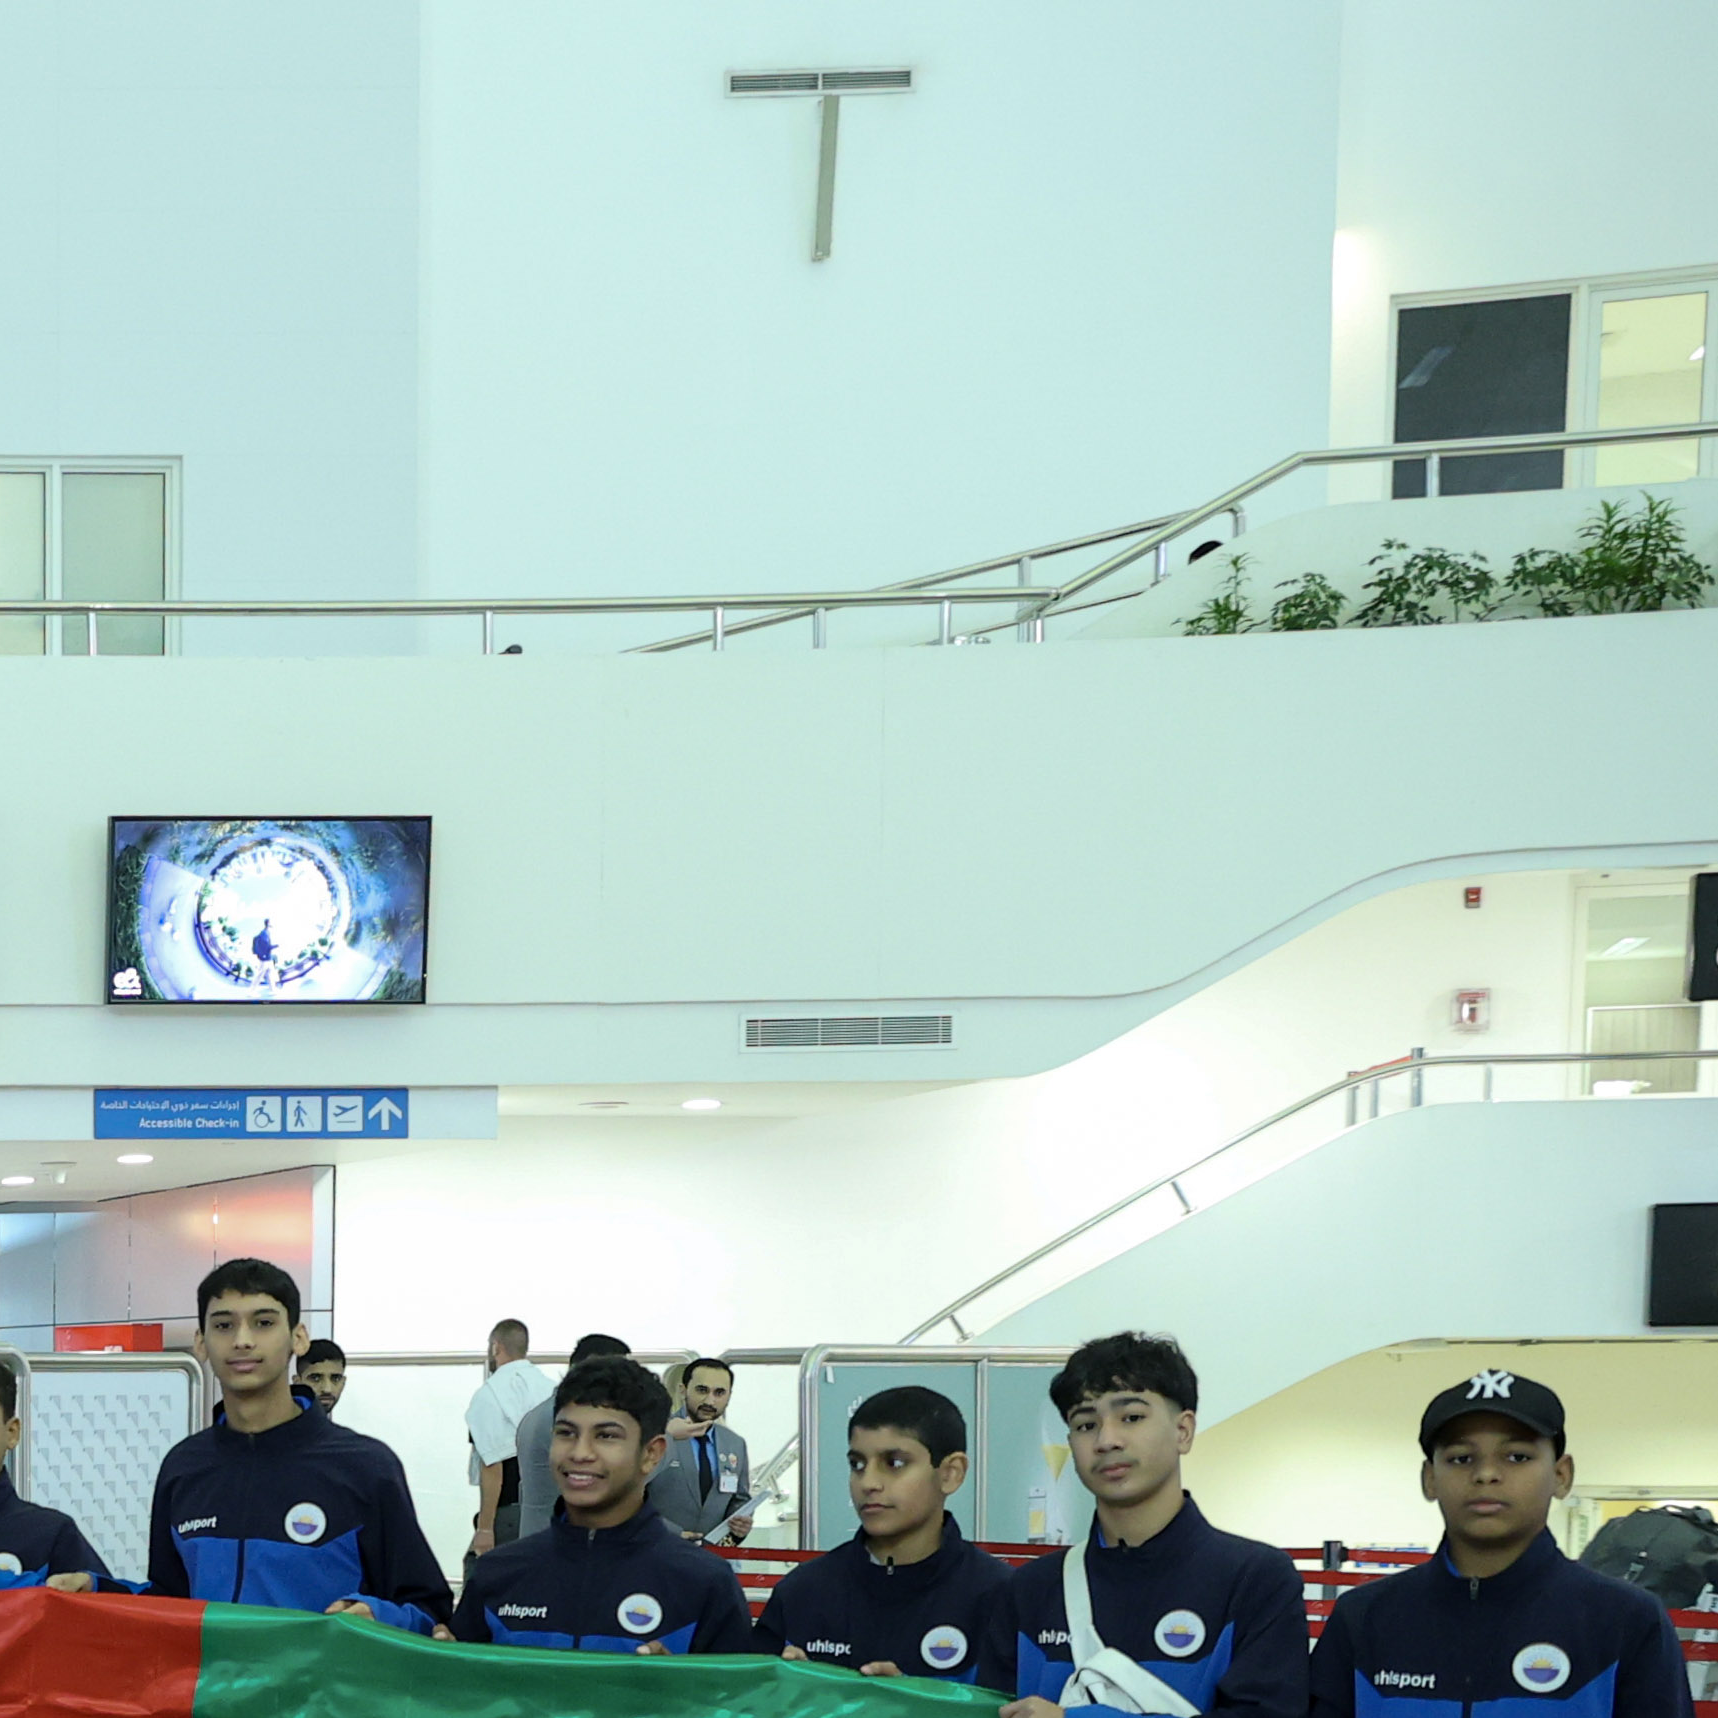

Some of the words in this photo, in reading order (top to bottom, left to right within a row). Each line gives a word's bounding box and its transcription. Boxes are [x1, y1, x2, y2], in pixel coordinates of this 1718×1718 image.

[139, 1118, 193, 1128] Accessible
[196, 1118, 239, 1128] Check-in
[498, 1604, 548, 1620] uhlsport
